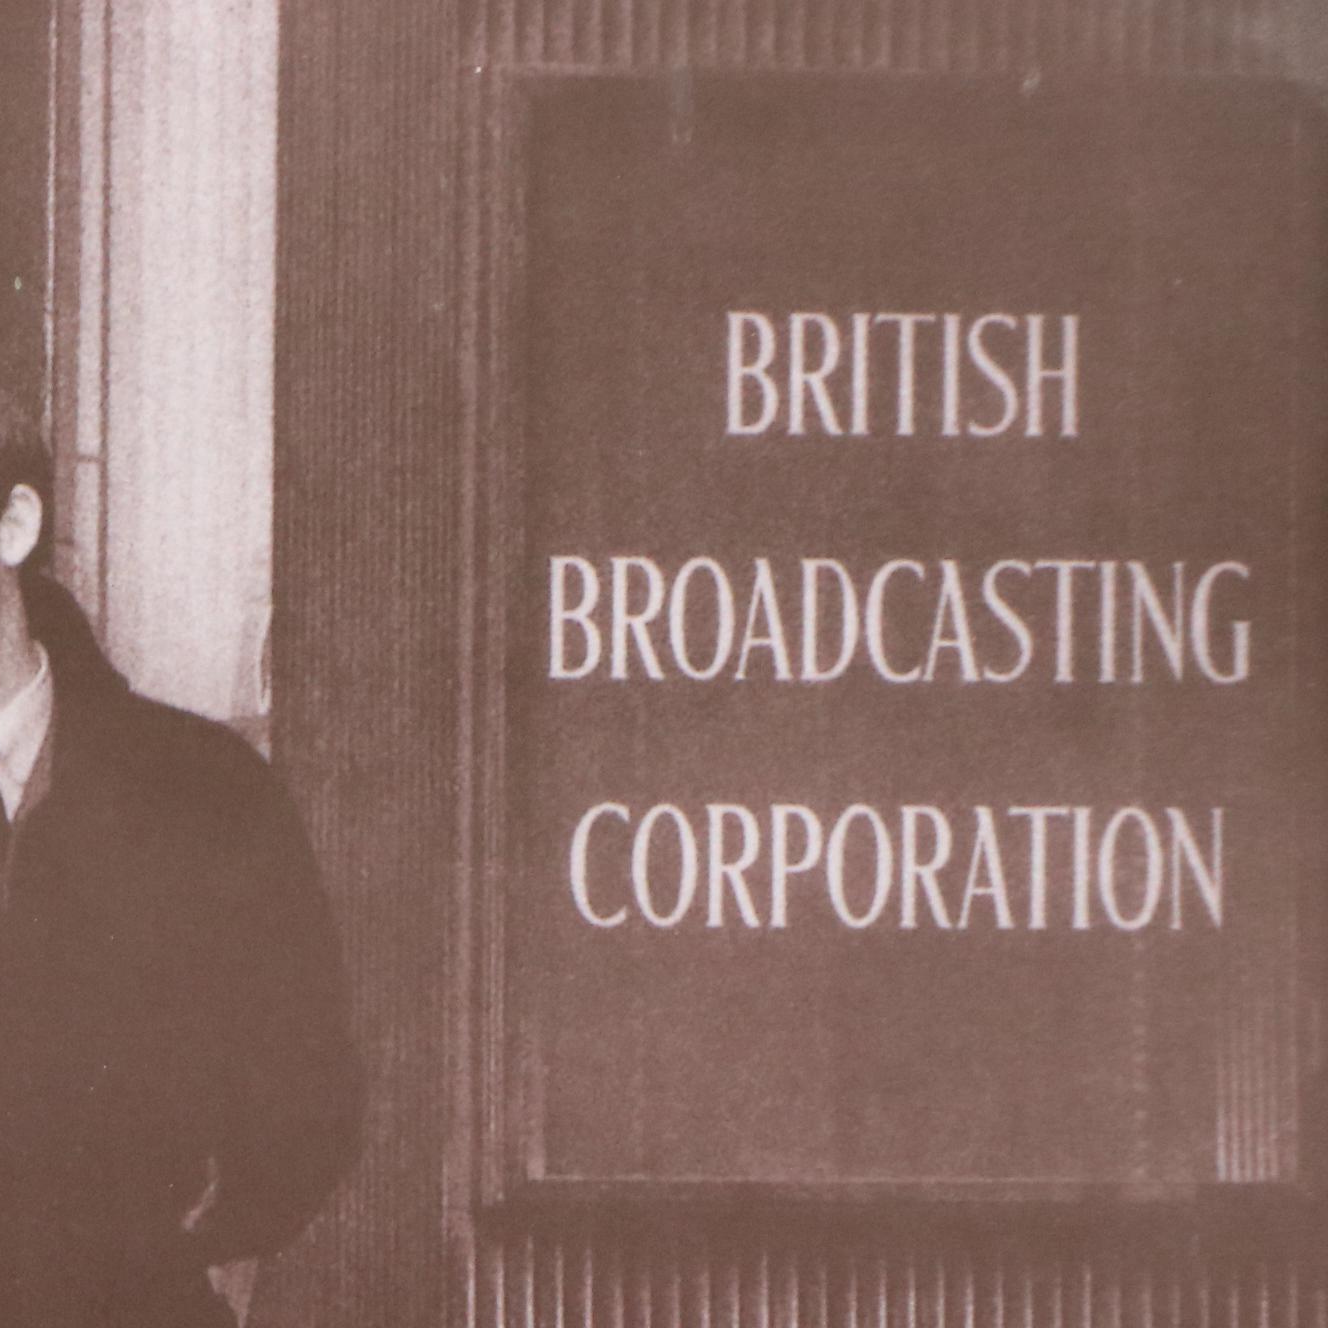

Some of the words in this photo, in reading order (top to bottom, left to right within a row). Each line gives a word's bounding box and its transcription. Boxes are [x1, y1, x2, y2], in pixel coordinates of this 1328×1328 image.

[725, 311, 1080, 438] BRITISH
[547, 554, 1251, 684] BROADCASTING
[568, 801, 1224, 931] CORPORATION
